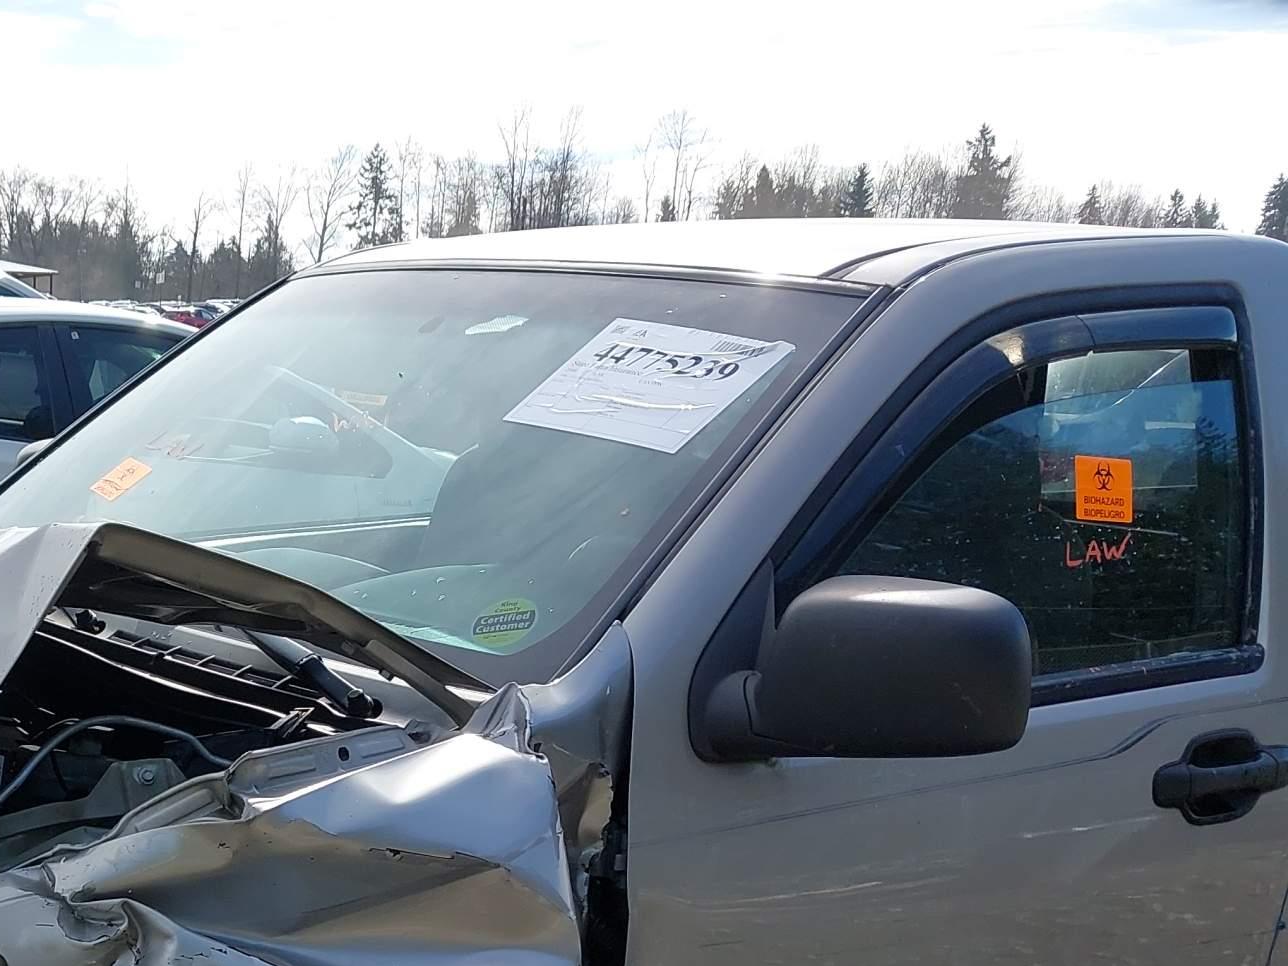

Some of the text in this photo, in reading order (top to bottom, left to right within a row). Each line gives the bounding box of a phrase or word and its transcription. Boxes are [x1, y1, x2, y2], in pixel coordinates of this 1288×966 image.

[593, 343, 741, 382] 44775239
[1083, 495, 1125, 507] BIOHAZARD
[1083, 508, 1125, 519] BIOPELIGRO
[1066, 532, 1132, 567] LAW
[480, 611, 531, 625] Certified
[475, 621, 531, 633] Customer
